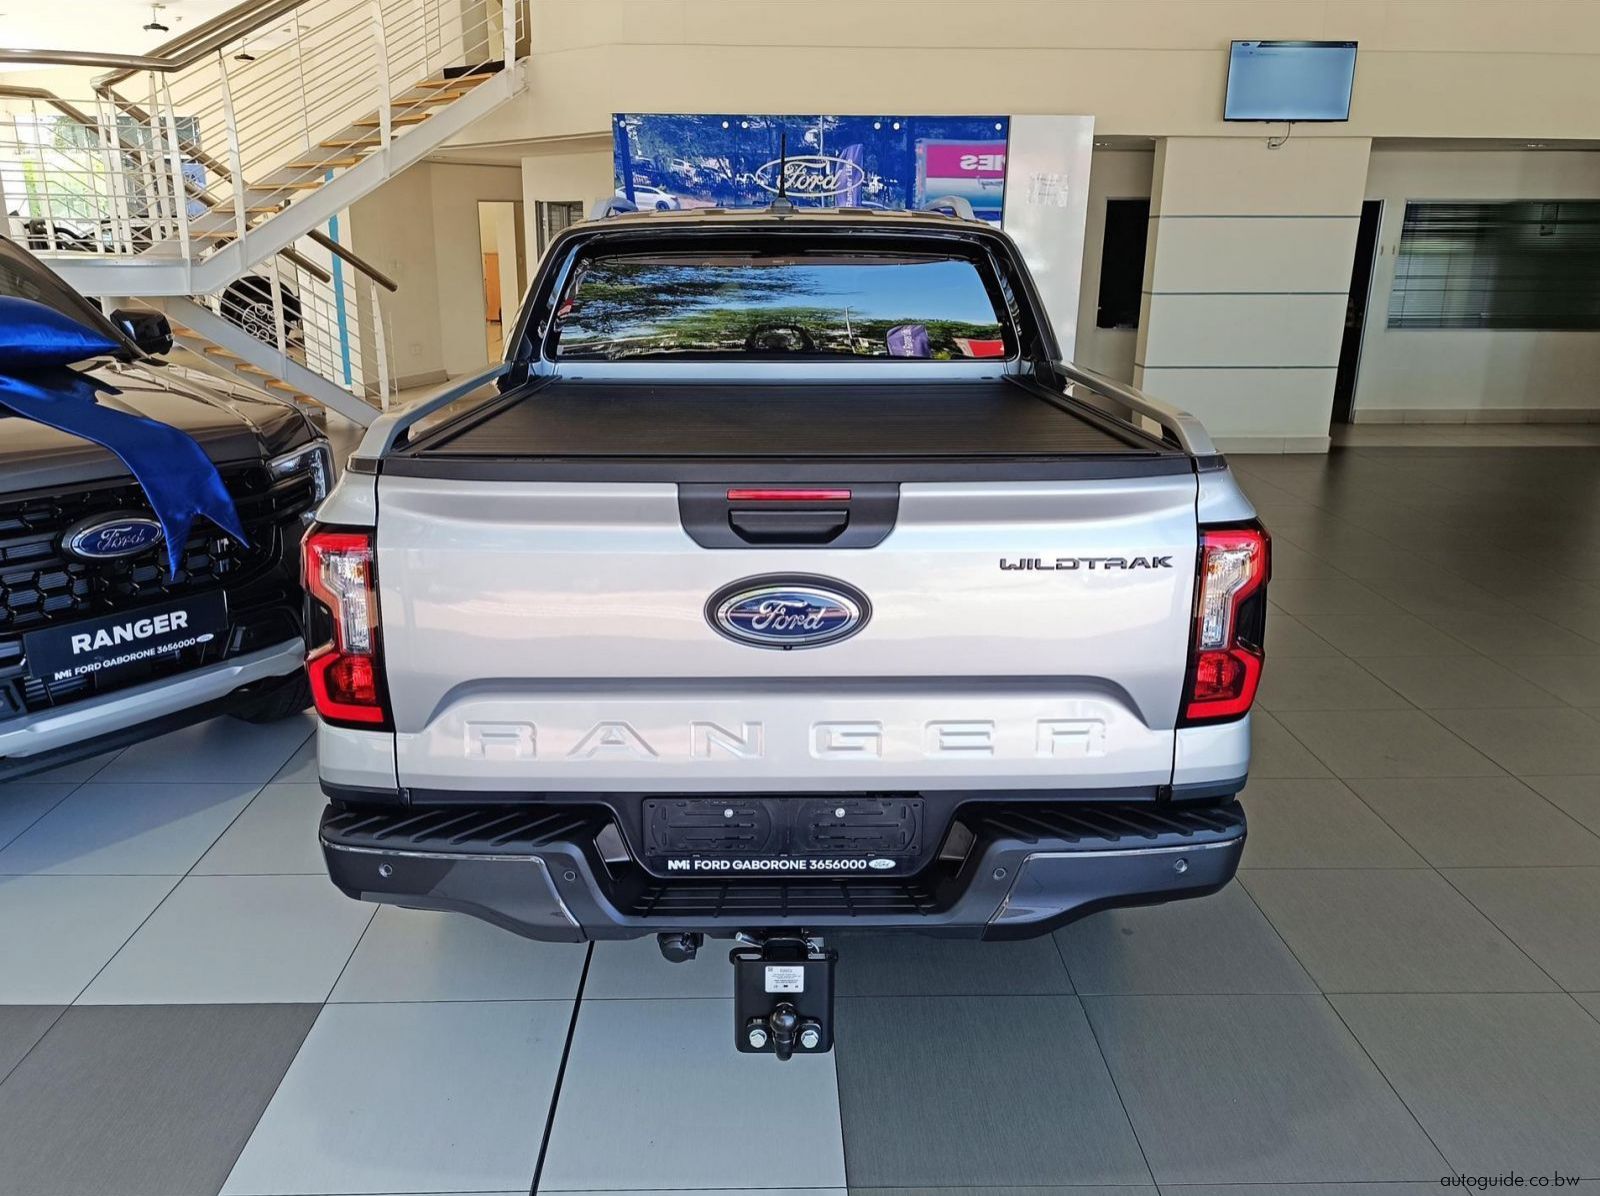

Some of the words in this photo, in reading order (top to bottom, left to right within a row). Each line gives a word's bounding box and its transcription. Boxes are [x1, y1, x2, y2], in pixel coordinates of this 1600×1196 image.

[777, 161, 843, 190] Ford
[97, 526, 144, 551] Ford
[999, 555, 1174, 571] WILDTRAK
[751, 599, 827, 631] Ford
[71, 610, 189, 655] RANGER
[75, 662, 102, 676] FORD
[102, 647, 156, 668] GABORONE
[157, 637, 196, 654] 3656000
[464, 718, 1107, 761] RANGER
[694, 859, 731, 870] FORD
[732, 859, 807, 870] GABORONE
[809, 859, 867, 870] 3656000
